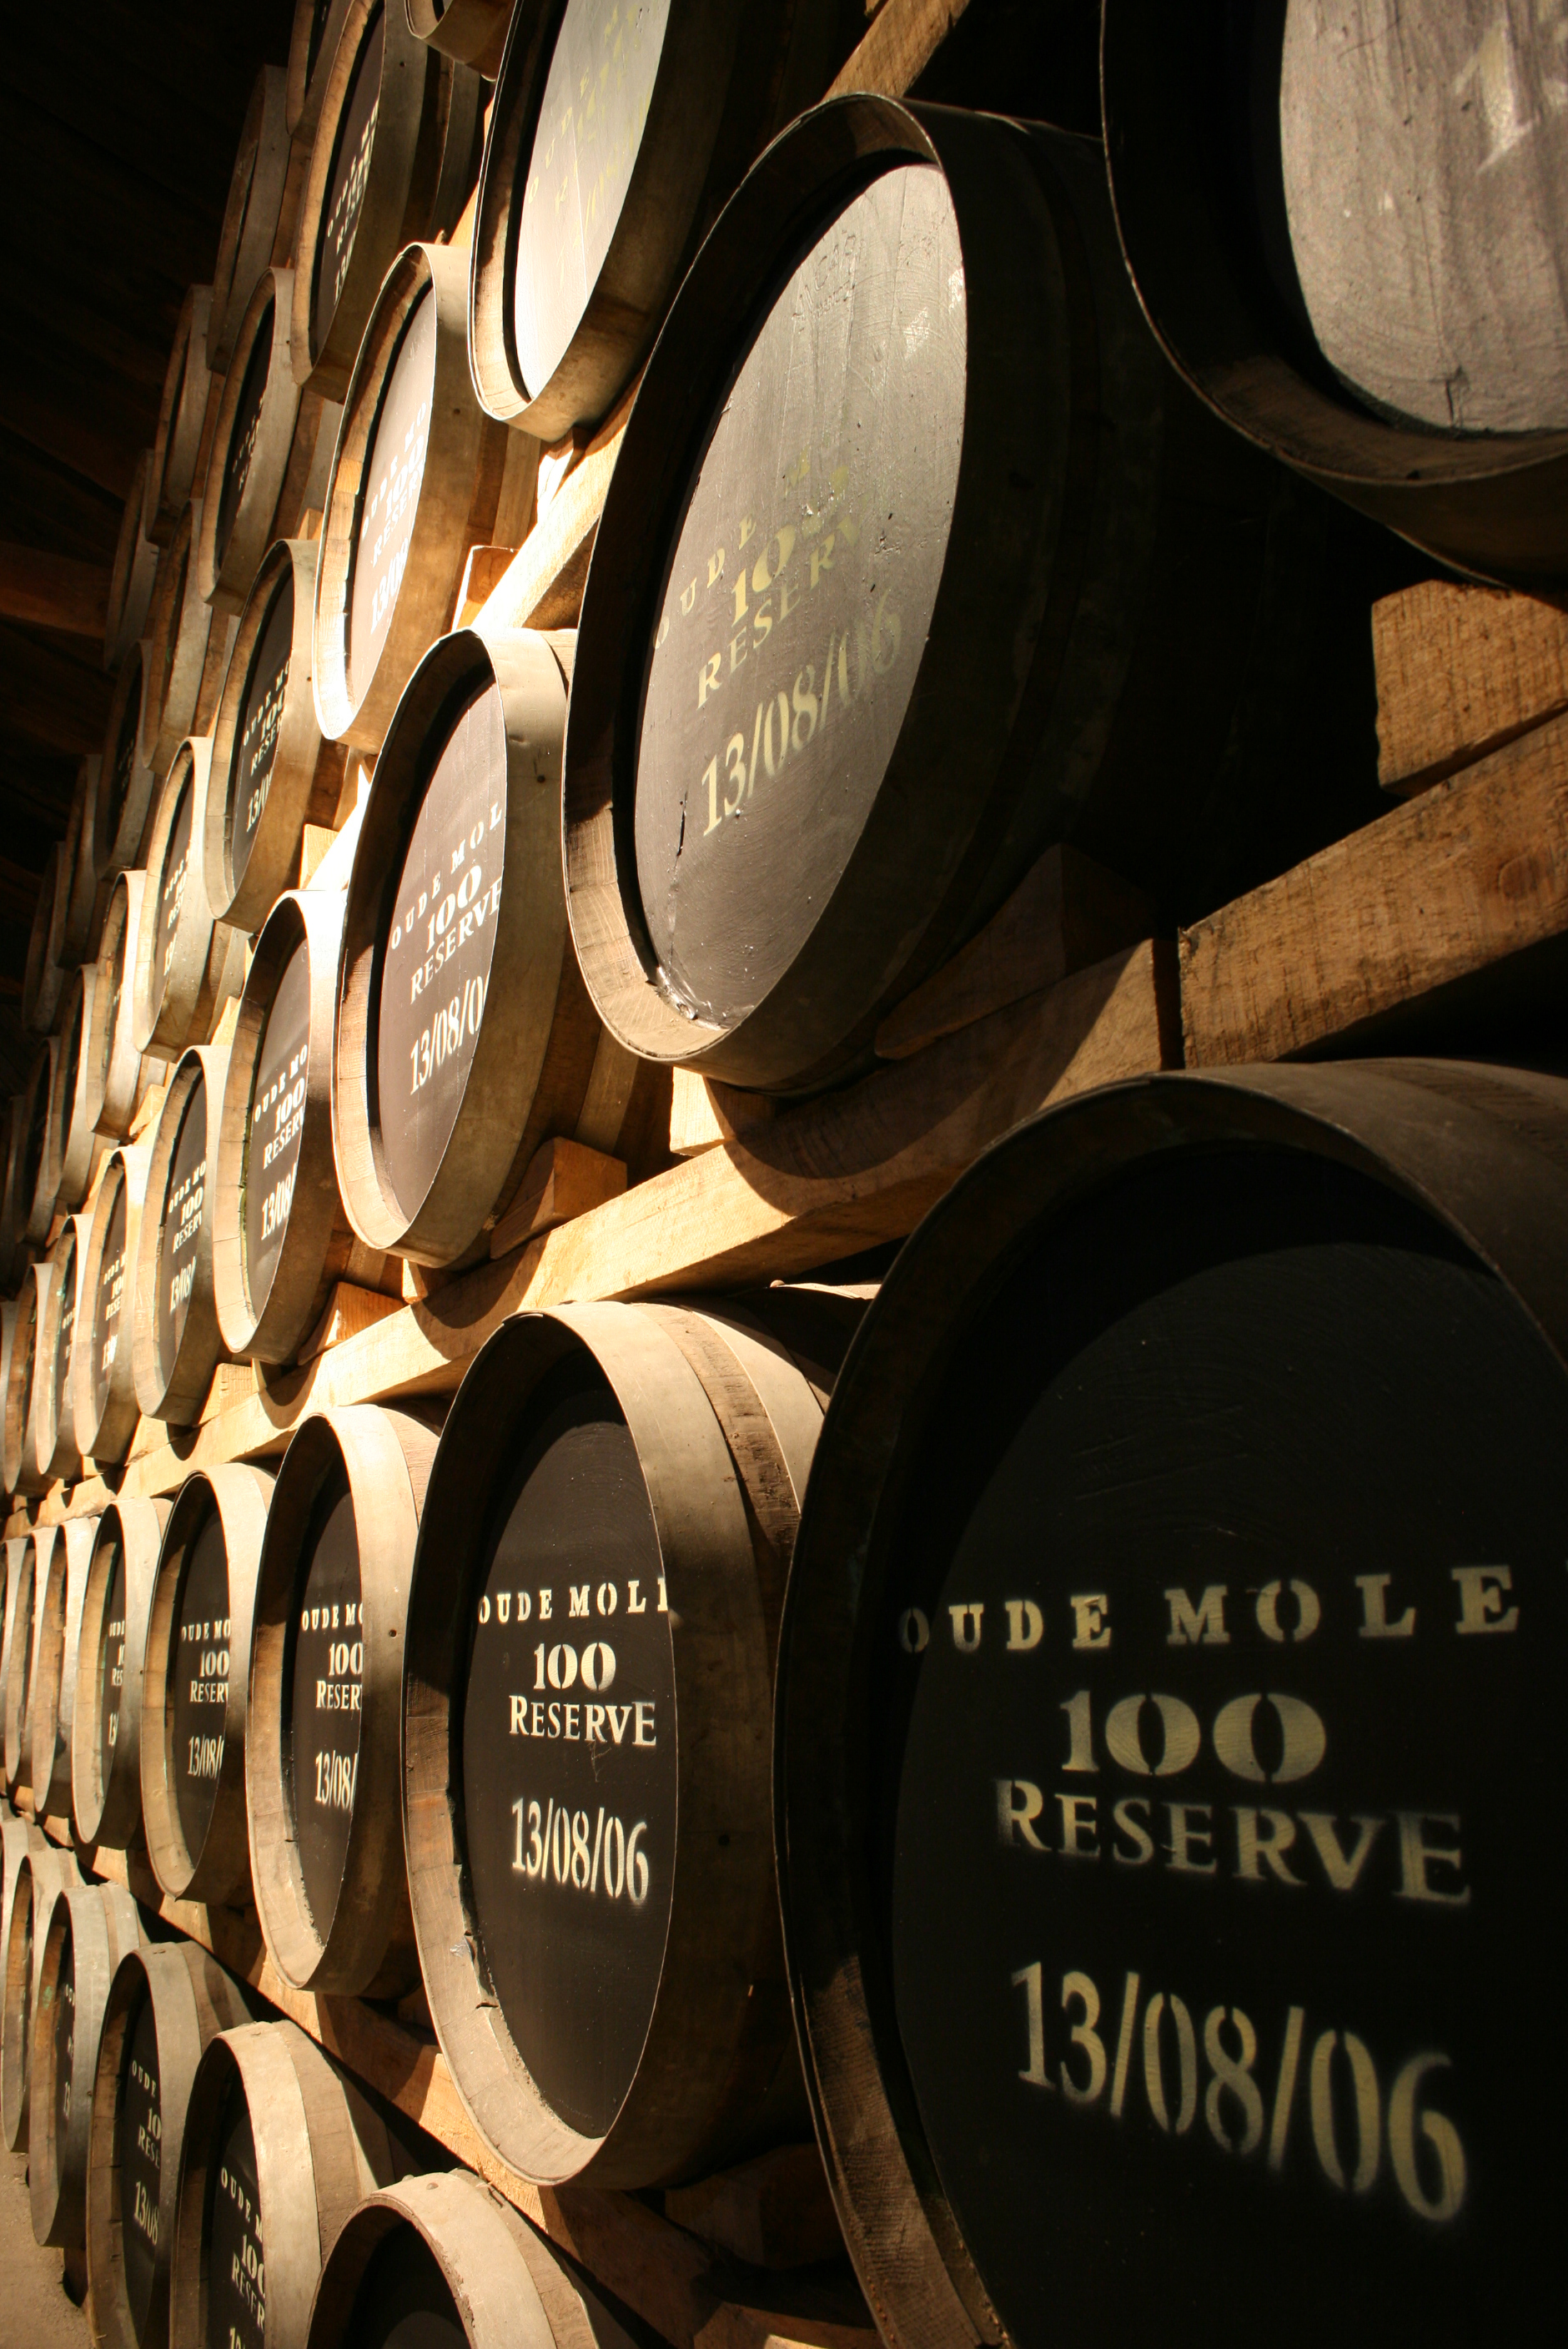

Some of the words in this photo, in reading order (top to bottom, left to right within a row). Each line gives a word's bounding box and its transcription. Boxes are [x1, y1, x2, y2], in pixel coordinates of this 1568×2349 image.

[391, 870, 441, 951] OUDE
[450, 801, 503, 874] MOL
[426, 864, 482, 954] 100
[410, 876, 503, 1004] RESERVE
[410, 970, 490, 1096] 13/08/0
[254, 1072, 286, 1123] OUDE
[289, 1044, 309, 1079] MO
[274, 1077, 305, 1134] 100
[168, 1175, 190, 1214] OUDE
[180, 1185, 204, 1226] 100
[182, 1622, 209, 1642] OUDE
[214, 1618, 231, 1640] MO
[302, 1605, 339, 1632] OUDE
[478, 1589, 554, 1624] OUDE
[899, 1593, 1113, 1653] OUDE
[1164, 1564, 1520, 1645] MOLE
[199, 1650, 230, 1677] 100
[328, 1642, 364, 1677] 100
[533, 1642, 616, 1693] 100
[315, 1680, 363, 1711] RESER
[509, 1694, 657, 1747] RESERVE
[1060, 1690, 1327, 1784] 100
[511, 1797, 650, 1906] 13/08/06
[994, 1778, 1471, 1908] RESERVE
[132, 2060, 157, 2098] OUDE
[1011, 1960, 1468, 2223] 13/08/06
[220, 2166, 251, 2222] OUDE
